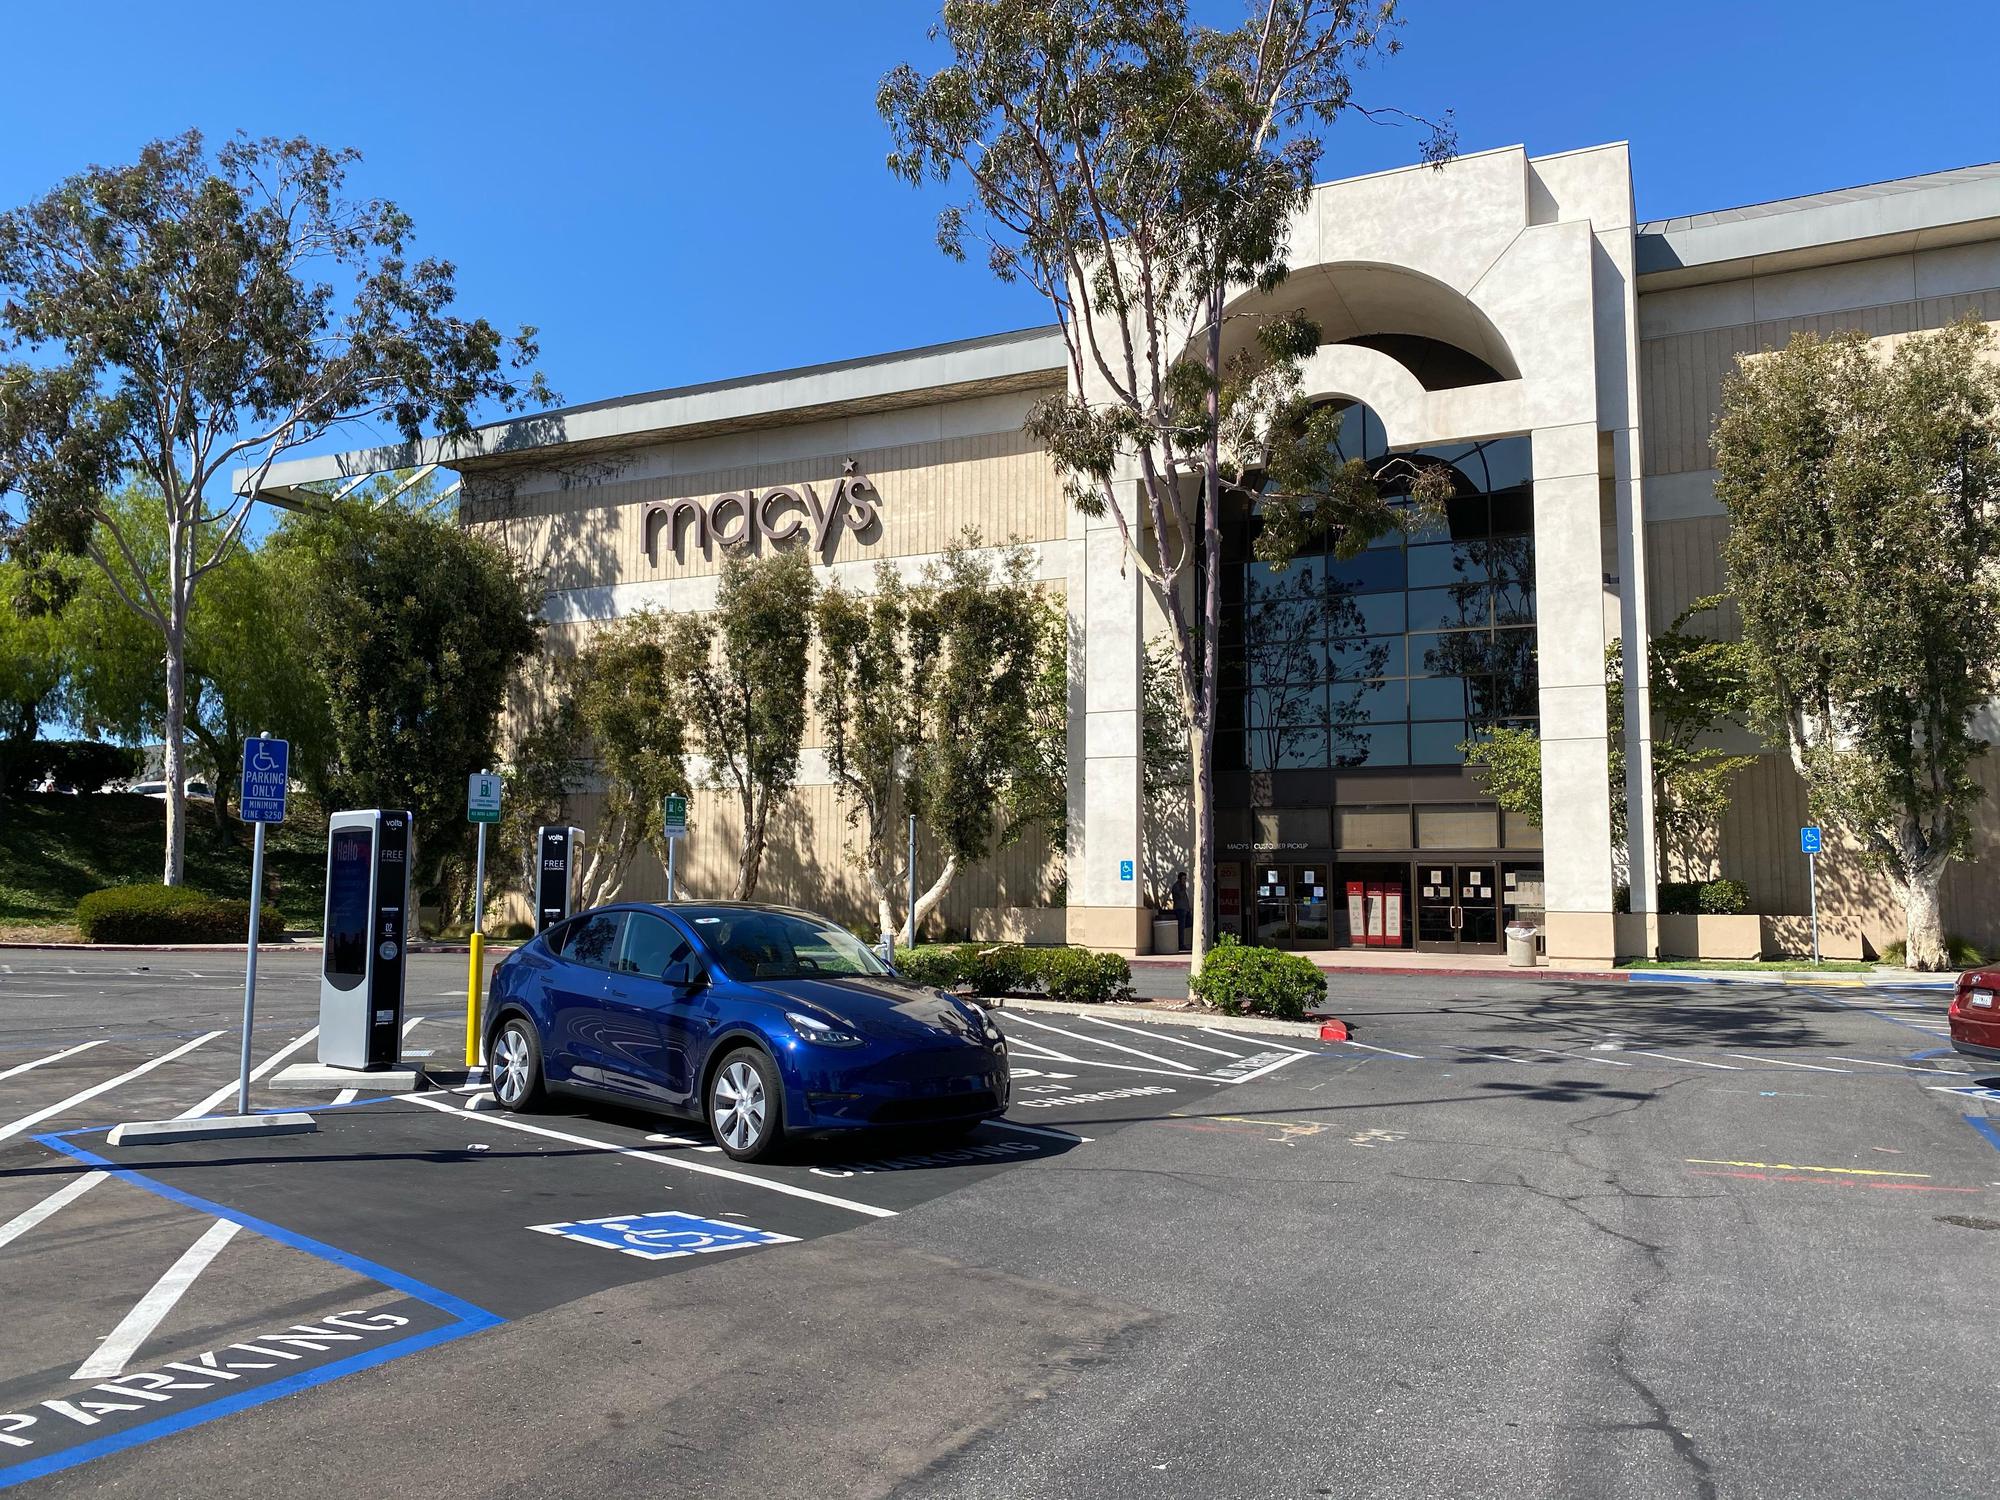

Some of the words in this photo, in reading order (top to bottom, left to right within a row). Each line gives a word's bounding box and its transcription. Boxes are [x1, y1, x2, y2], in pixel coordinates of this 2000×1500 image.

[246, 771, 284, 784] PARKING
[252, 785, 277, 797] ONLY
[249, 801, 278, 809] MINIMUM
[243, 810, 258, 819] FINE
[337, 839, 358, 861] Hello
[381, 850, 404, 859] FREE
[544, 859, 564, 867] FREE
[385, 922, 393, 932] 02
[1018, 1083, 1073, 1094] EV
[1017, 1085, 1177, 1108] CHARGING
[809, 1141, 1041, 1178] CHARGING
[0, 1310, 410, 1447] PARKING
